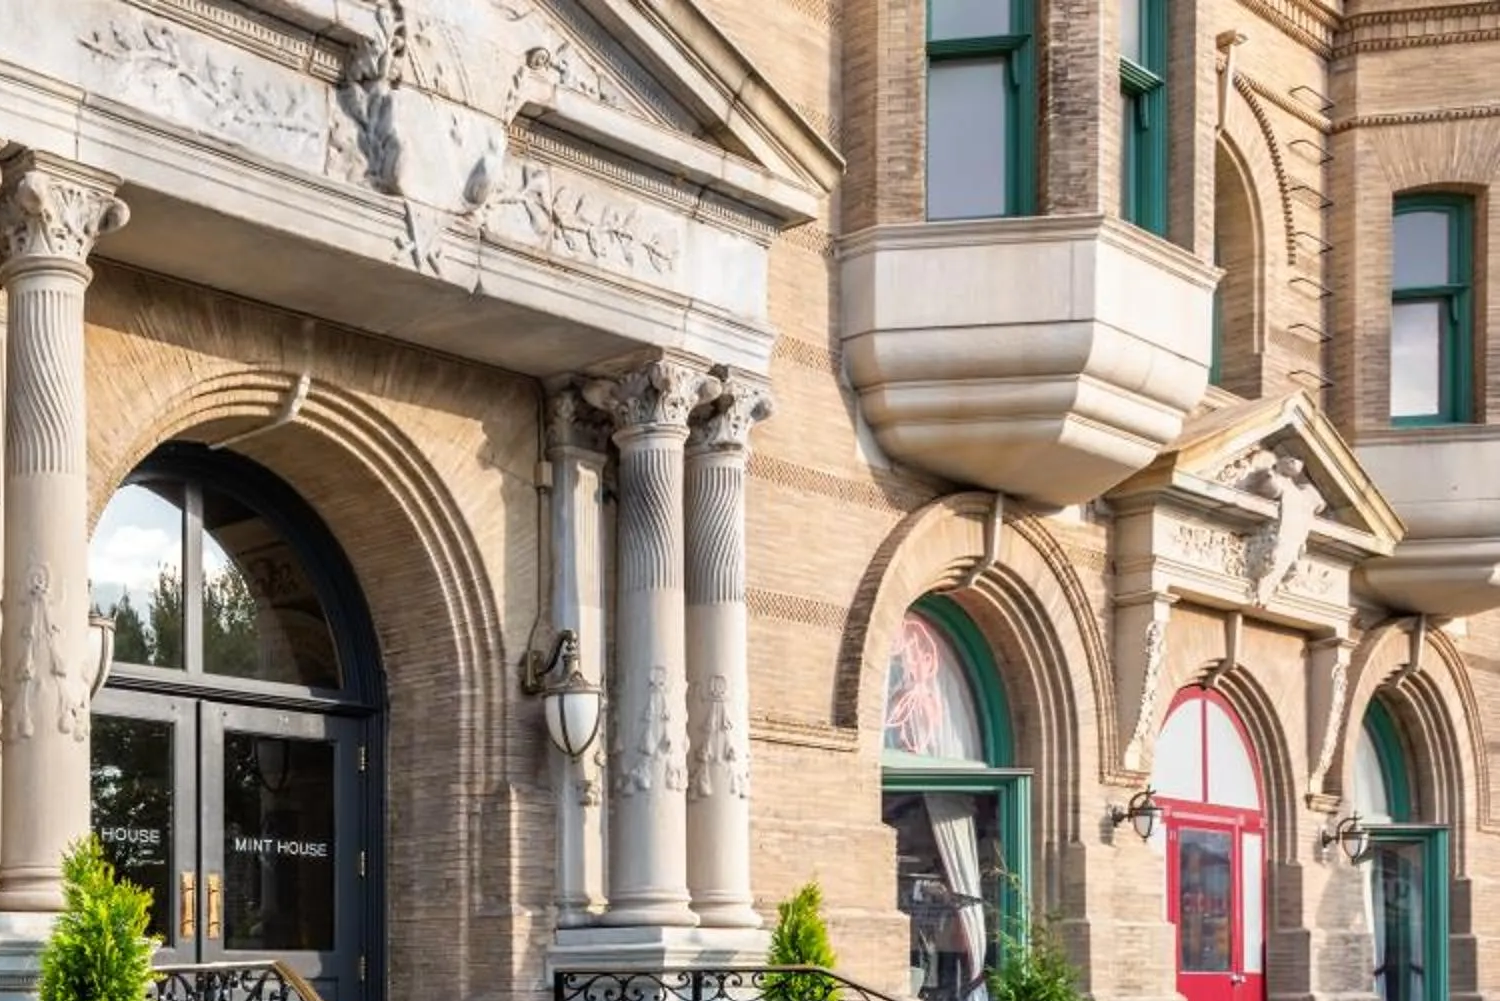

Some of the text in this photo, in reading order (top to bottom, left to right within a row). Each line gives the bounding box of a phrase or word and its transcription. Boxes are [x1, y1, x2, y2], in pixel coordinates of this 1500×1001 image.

[101, 827, 161, 843] HOUSE
[235, 837, 328, 857] MINT HOUSE
